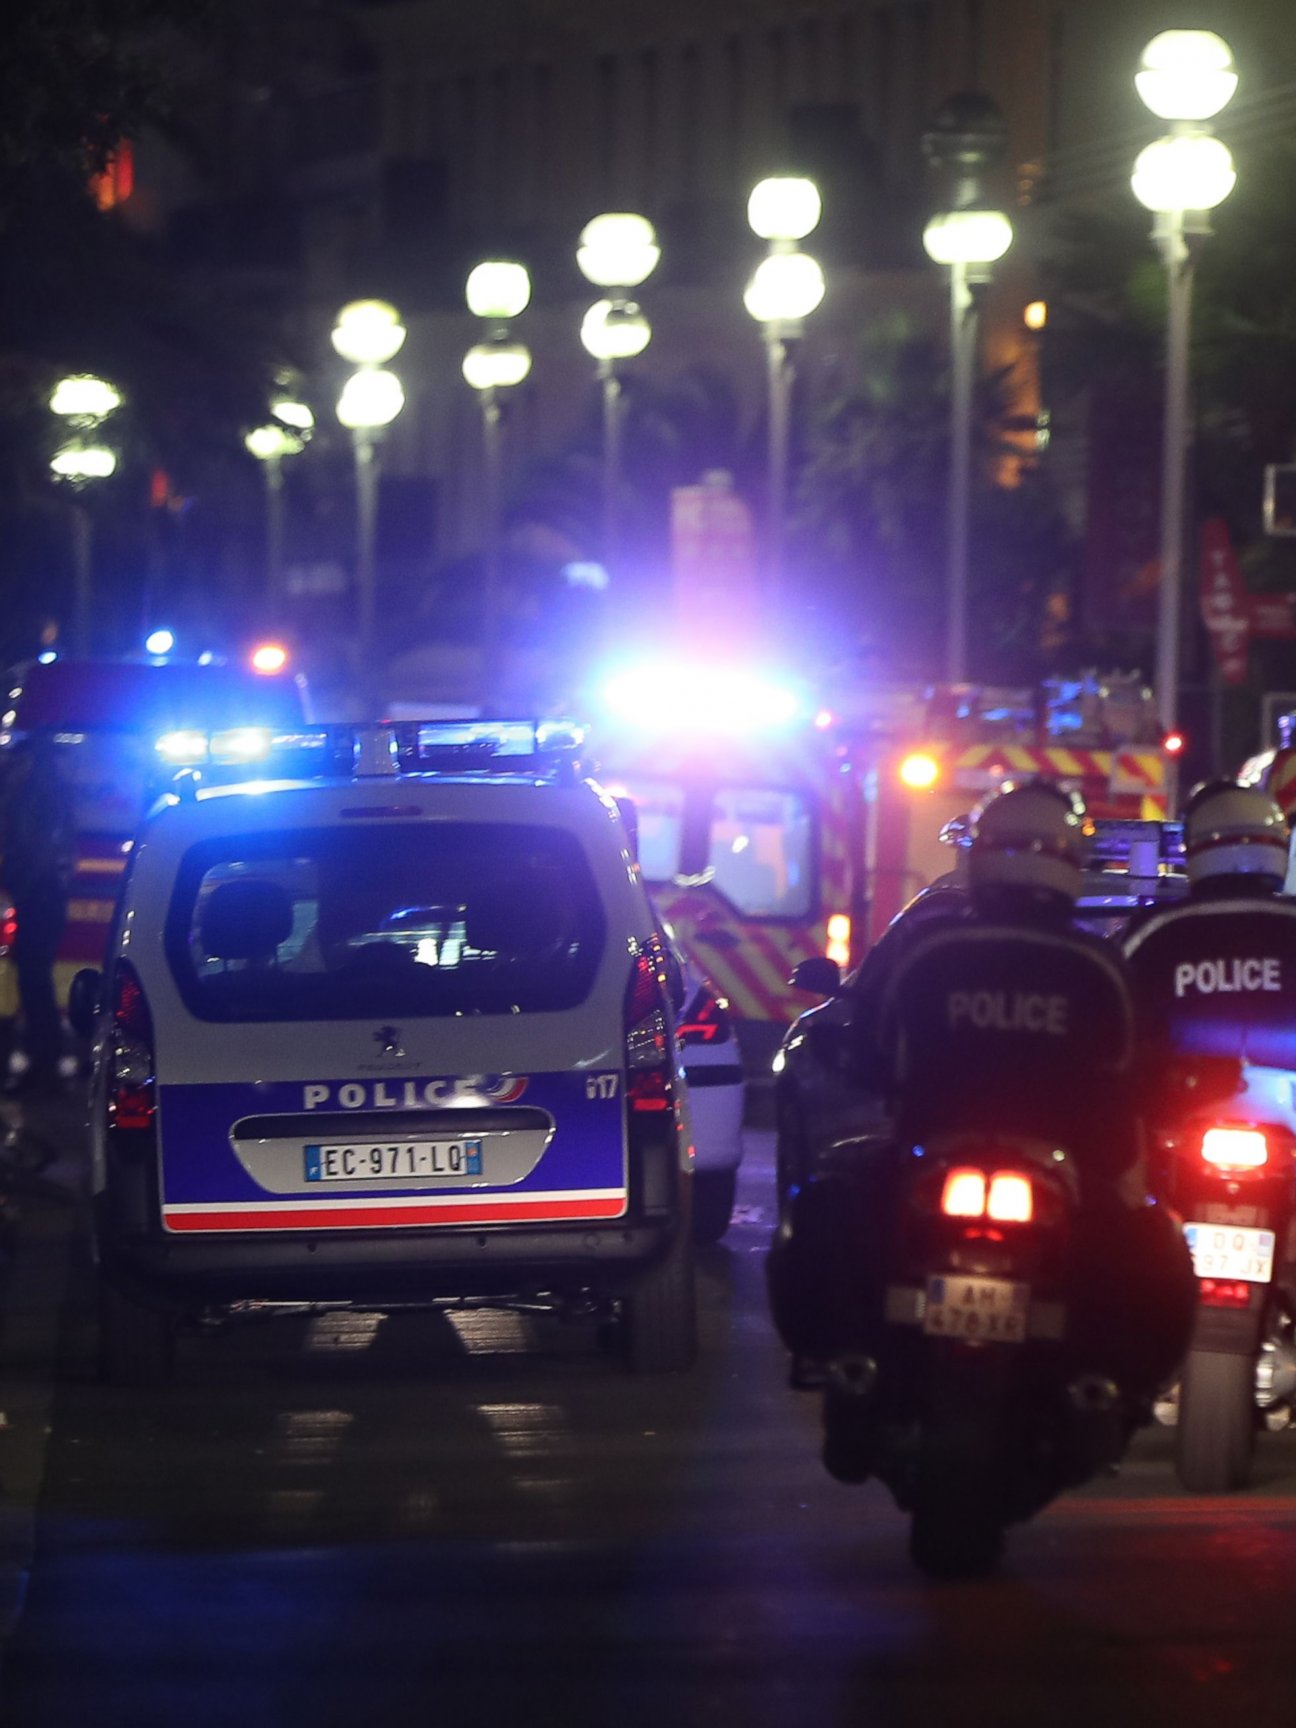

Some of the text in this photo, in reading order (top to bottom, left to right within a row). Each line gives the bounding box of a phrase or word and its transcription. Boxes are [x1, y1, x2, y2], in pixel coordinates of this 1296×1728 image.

[1174, 958, 1282, 997] POLICE
[946, 989, 1069, 1036] POLICE
[303, 1078, 482, 1110] POLICE
